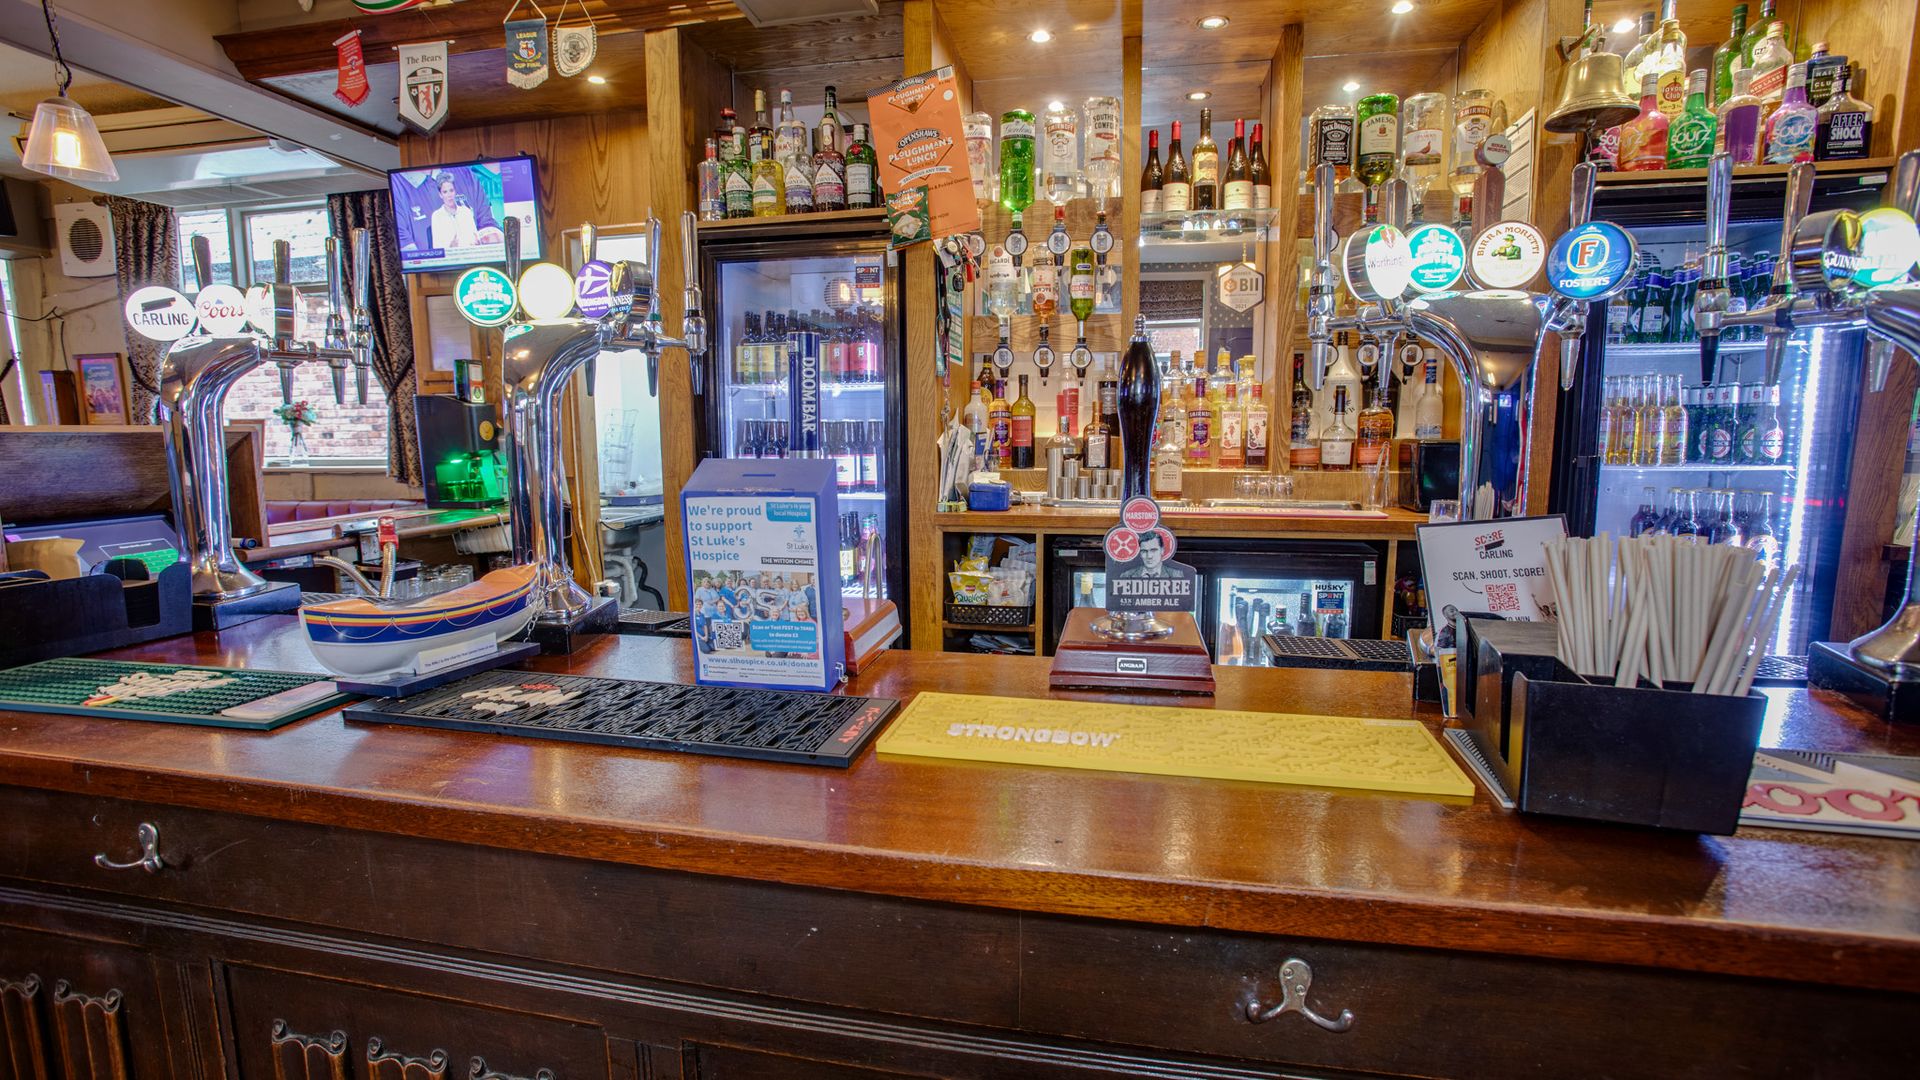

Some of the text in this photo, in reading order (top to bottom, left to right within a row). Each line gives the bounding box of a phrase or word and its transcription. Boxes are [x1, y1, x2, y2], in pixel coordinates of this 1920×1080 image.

[406, 55, 442, 65] The Bears
[1366, 115, 1395, 128] JAMESON
[1832, 113, 1864, 127] AFTER
[1671, 128, 1712, 144] sourz
[1830, 126, 1862, 141] SHOCK
[1600, 136, 1620, 147] sou
[907, 151, 937, 167] LUNCH
[1477, 229, 1503, 257] BIRRA
[1505, 226, 1540, 255] MORETTI
[1576, 240, 1599, 267] F
[198, 300, 246, 319] Coors
[132, 312, 190, 326] CARLING
[802, 356, 816, 433] DOOM BAR
[688, 504, 762, 518] We're proud
[689, 521, 753, 533] to support
[691, 535, 745, 546] St Luke's
[786, 542, 814, 551] St Luke's
[692, 551, 740, 563] Hospice
[1479, 549, 1514, 560] CARLING
[1452, 567, 1545, 581] SCAN, SHOOT, SCORE!
[1111, 579, 1191, 596] PEDIGREE
[1135, 598, 1162, 607] AMBER
[1164, 598, 1180, 607] ALE
[708, 656, 819, 669] www.slhospice.co.uk/donate
[946, 722, 1117, 748] STRONGBOW
